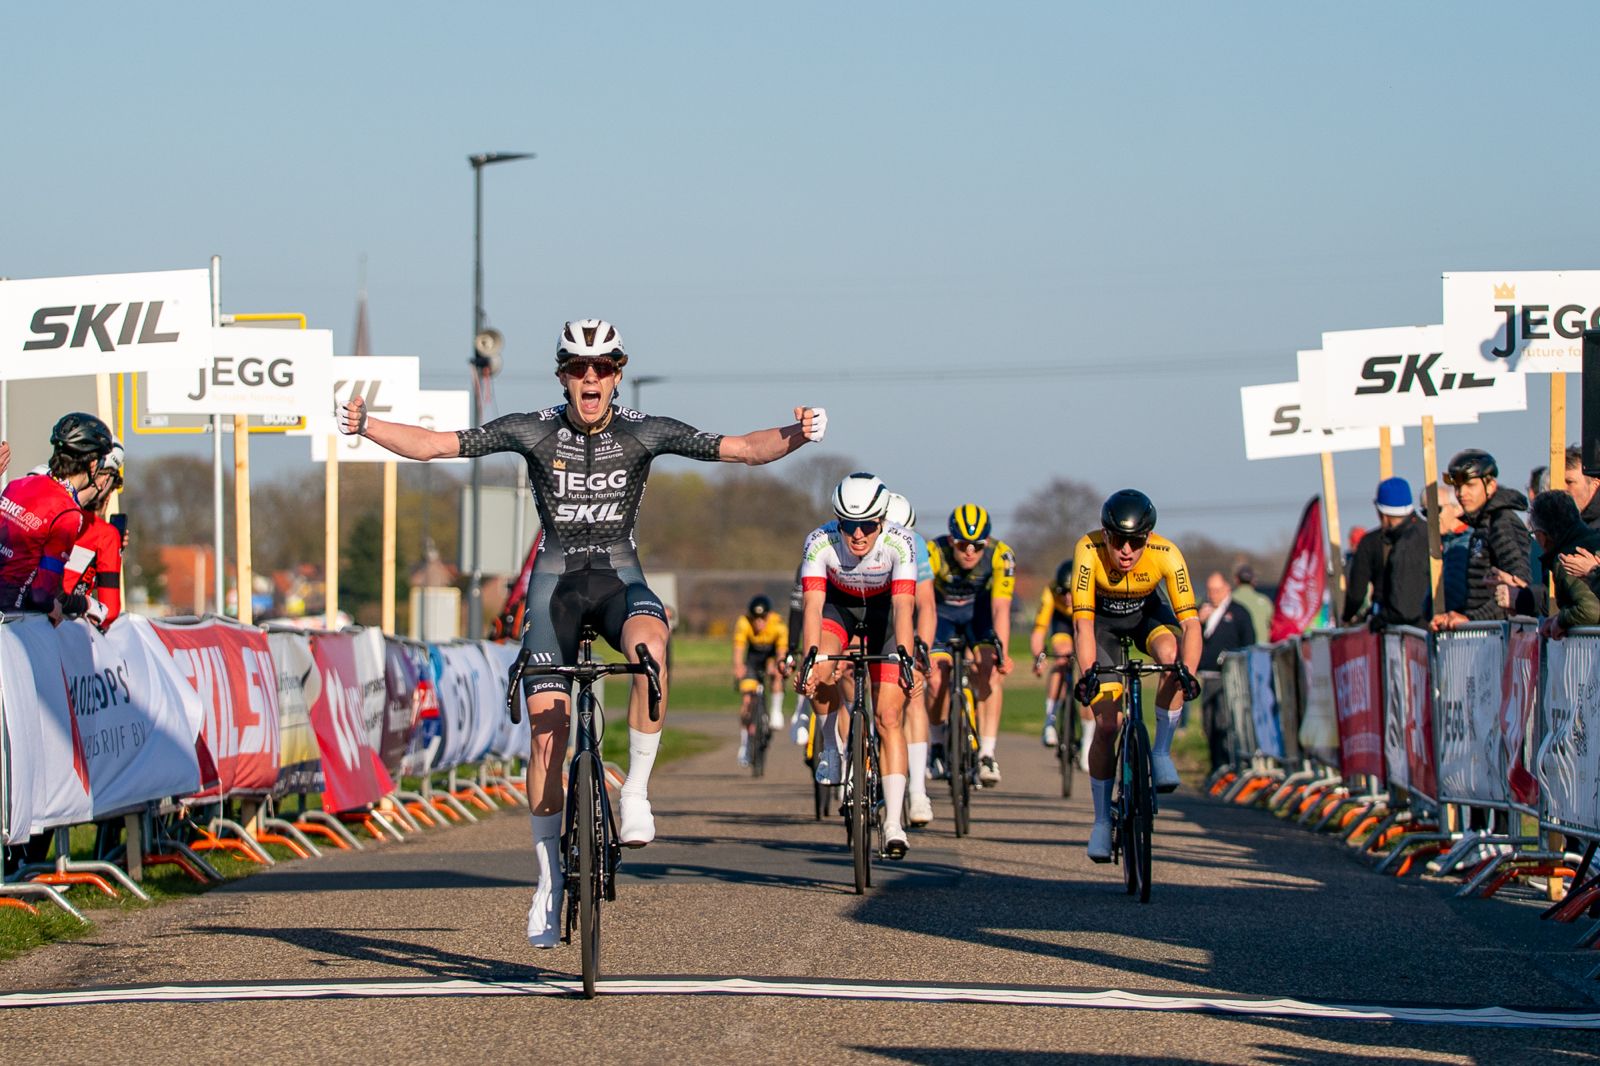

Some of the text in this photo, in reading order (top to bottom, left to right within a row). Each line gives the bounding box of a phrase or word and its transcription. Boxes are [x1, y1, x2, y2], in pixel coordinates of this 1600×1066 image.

[23, 300, 180, 352] SKIL
[187, 356, 295, 401] JEGG
[552, 469, 628, 498] JEGG
[568, 489, 627, 500] future farming
[554, 502, 624, 524] SKIL
[532, 682, 566, 693] JEGG.NL
